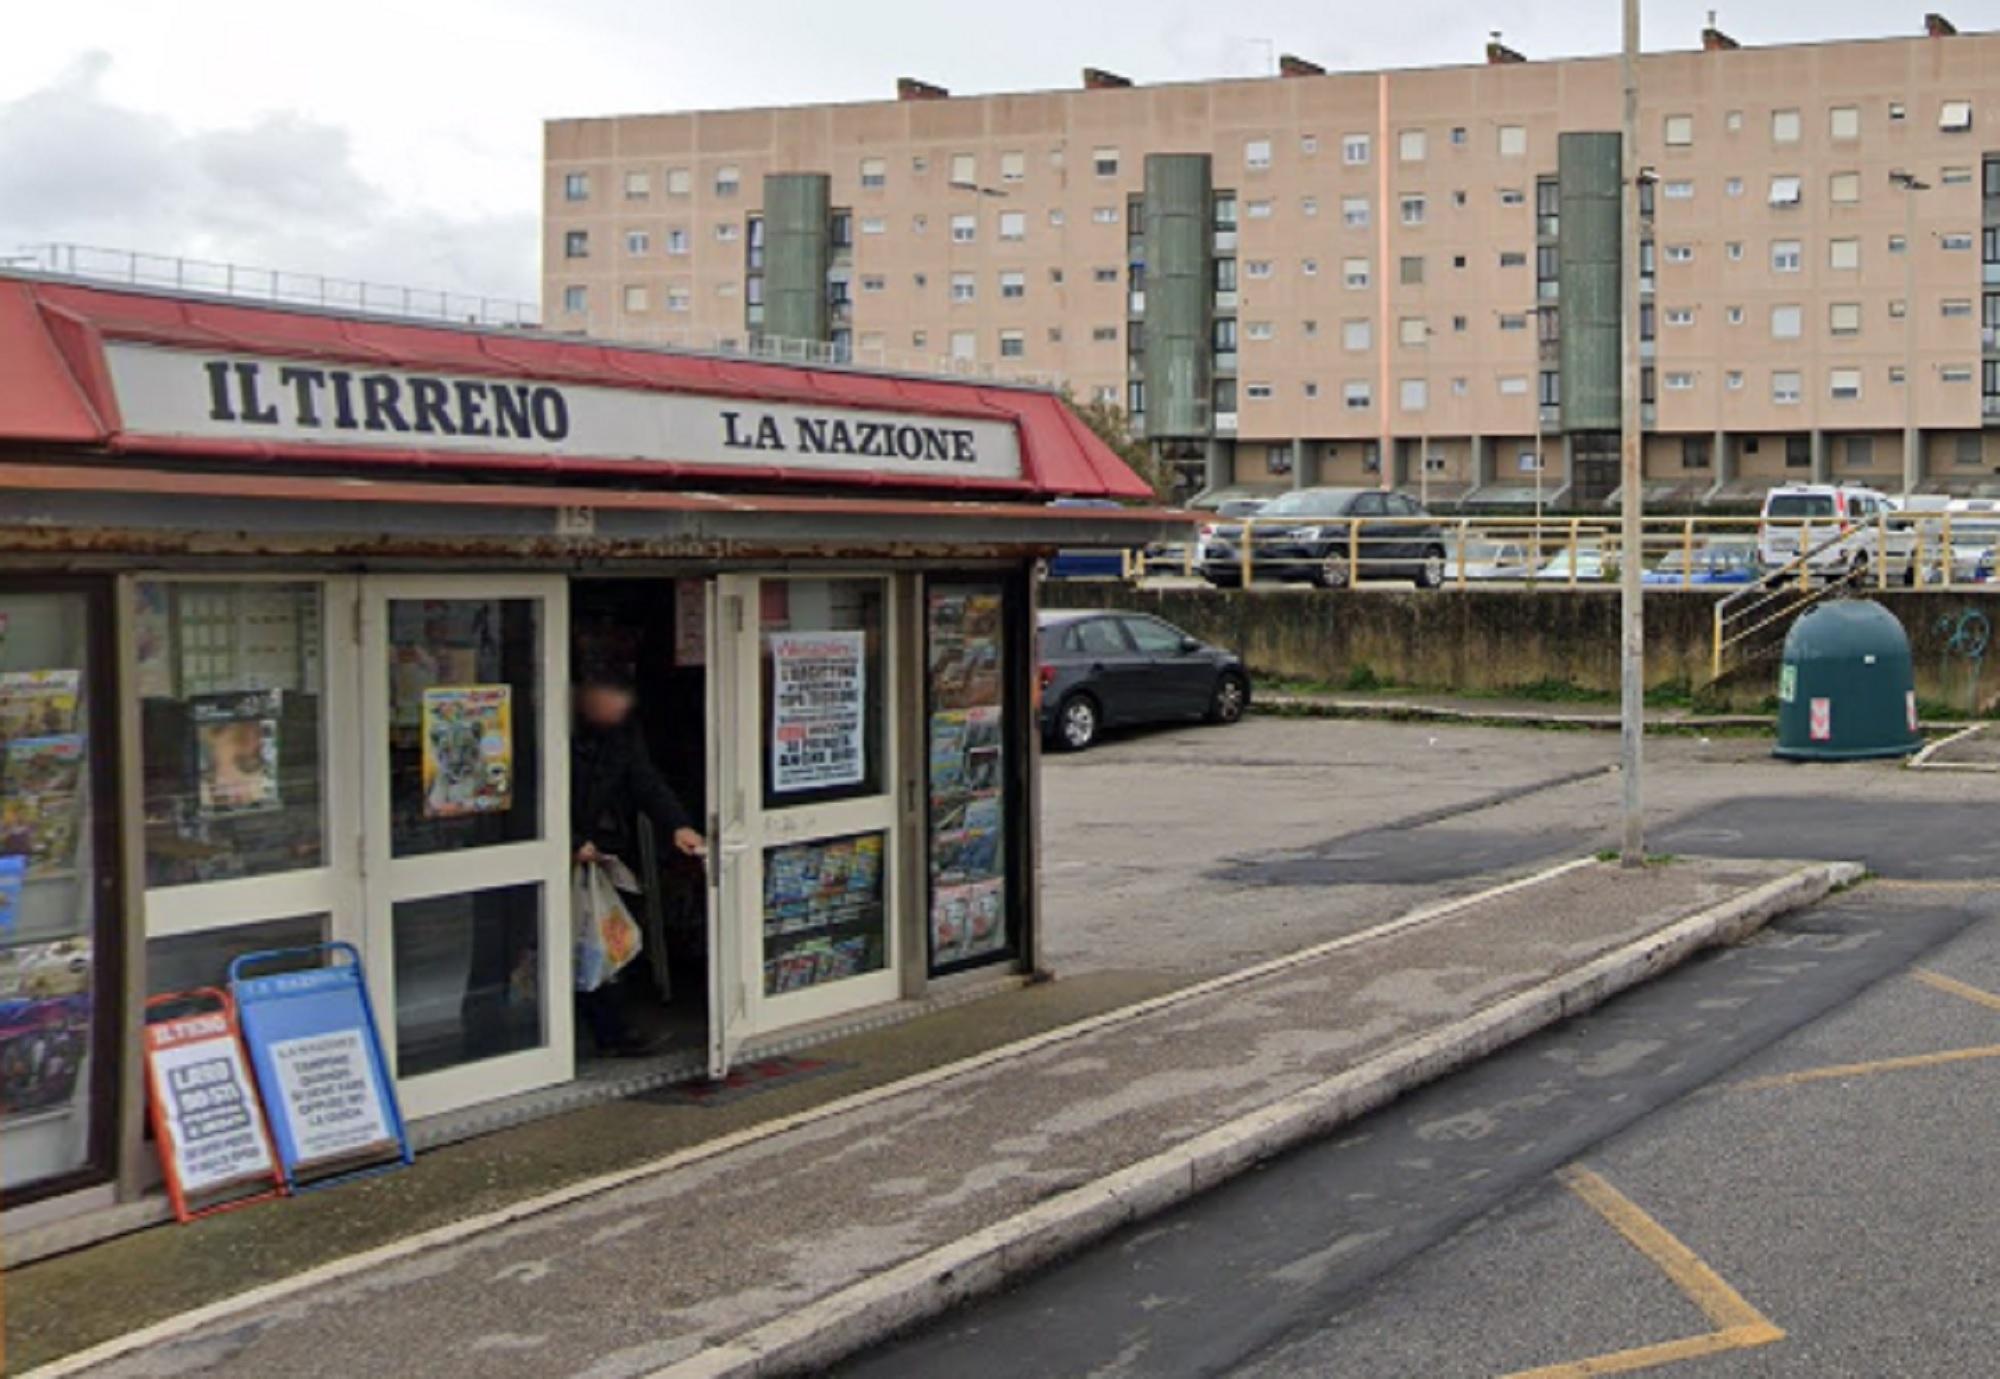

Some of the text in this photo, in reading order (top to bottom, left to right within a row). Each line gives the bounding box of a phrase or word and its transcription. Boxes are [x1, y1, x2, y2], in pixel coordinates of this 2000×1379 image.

[205, 361, 569, 442] IL TIRRENO
[720, 411, 976, 462] LA NAZIONE
